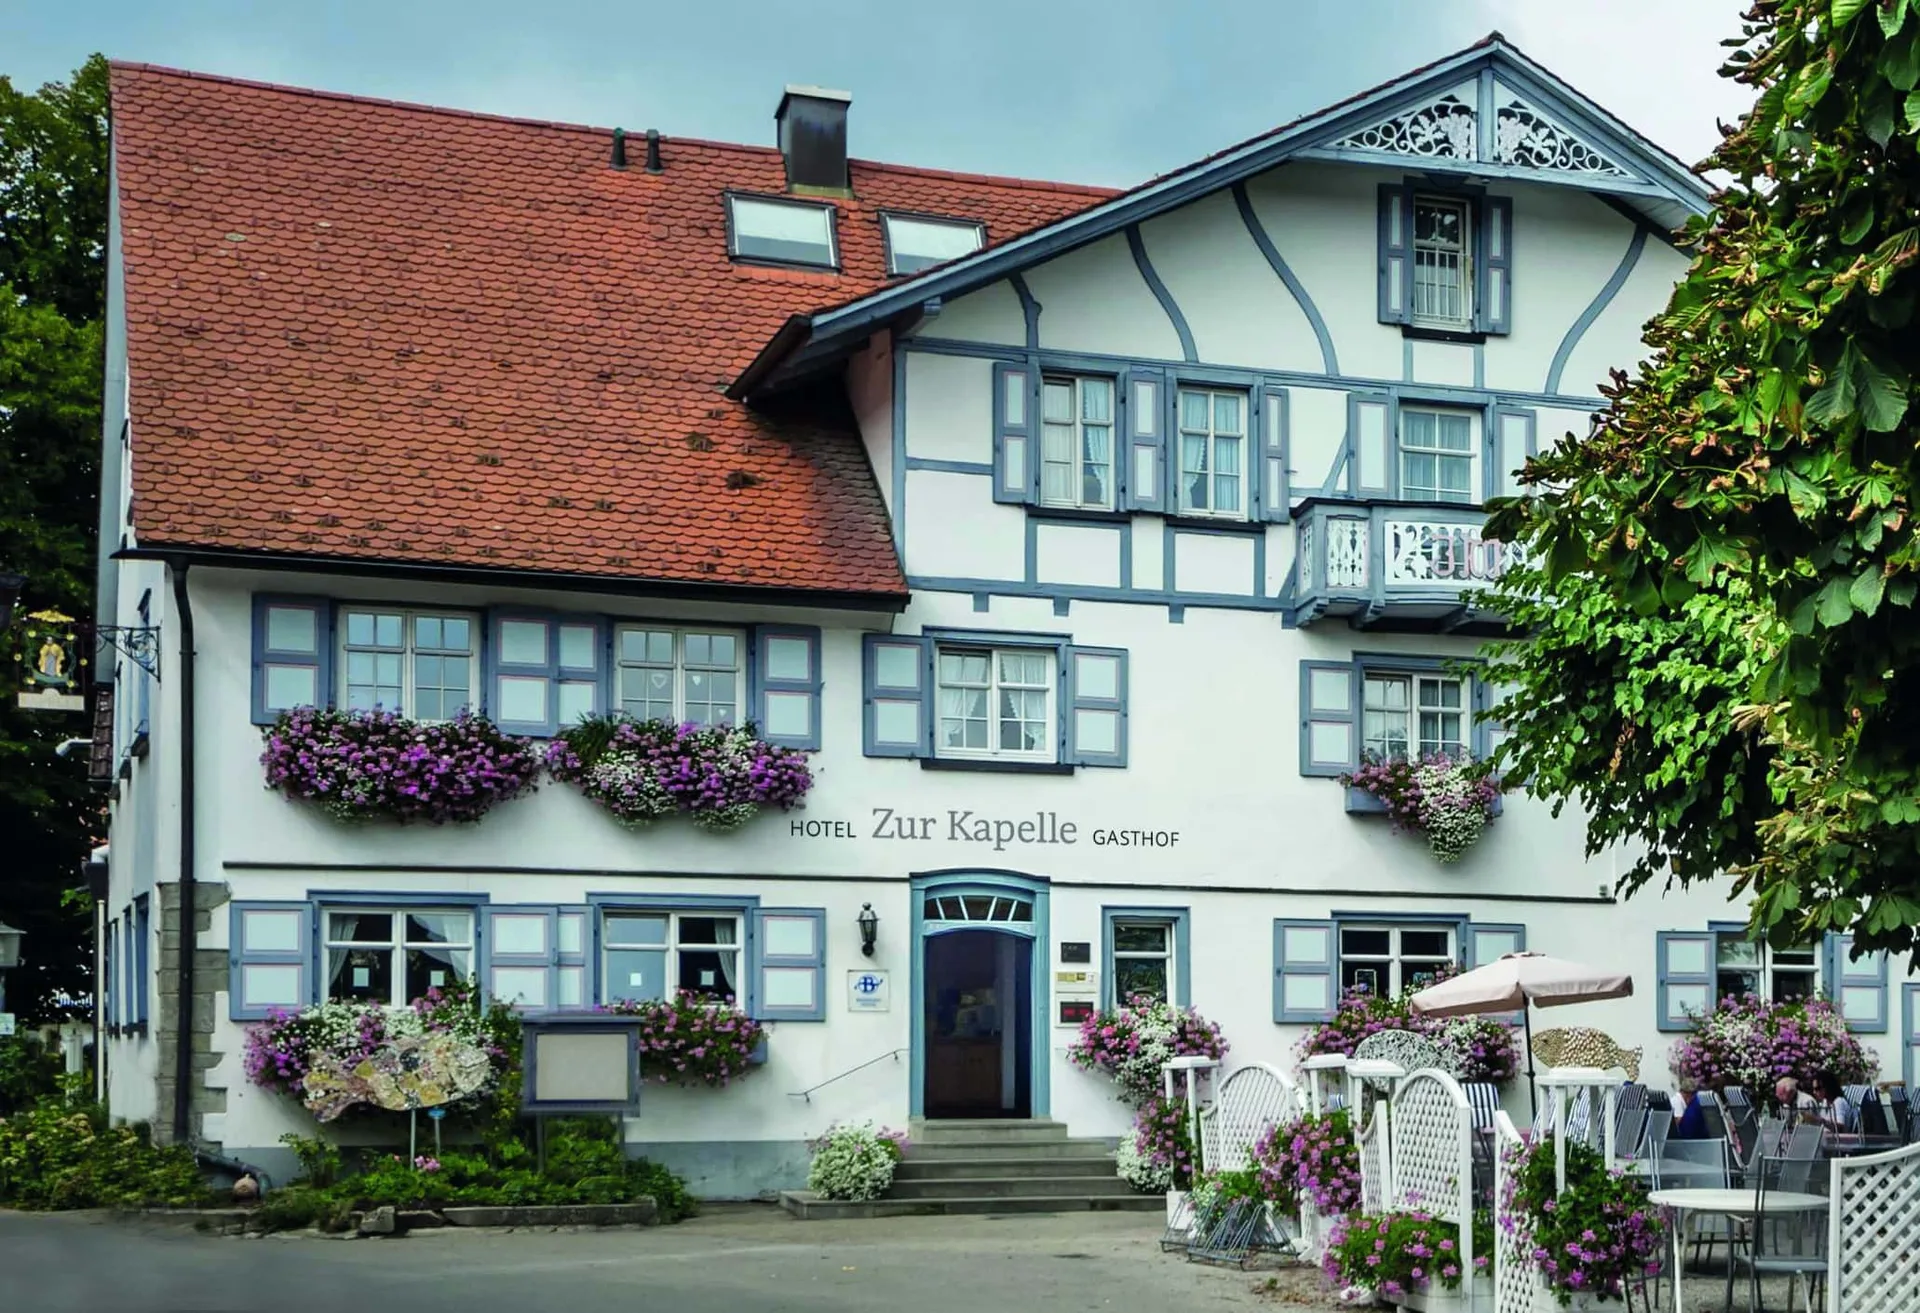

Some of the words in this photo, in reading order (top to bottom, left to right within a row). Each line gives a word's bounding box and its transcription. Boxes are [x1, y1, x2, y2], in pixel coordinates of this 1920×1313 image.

[790, 820, 857, 838] HOTEL
[872, 808, 937, 840] Zur
[947, 811, 1078, 851] Kapelle
[1092, 829, 1180, 848] GASTHOF
